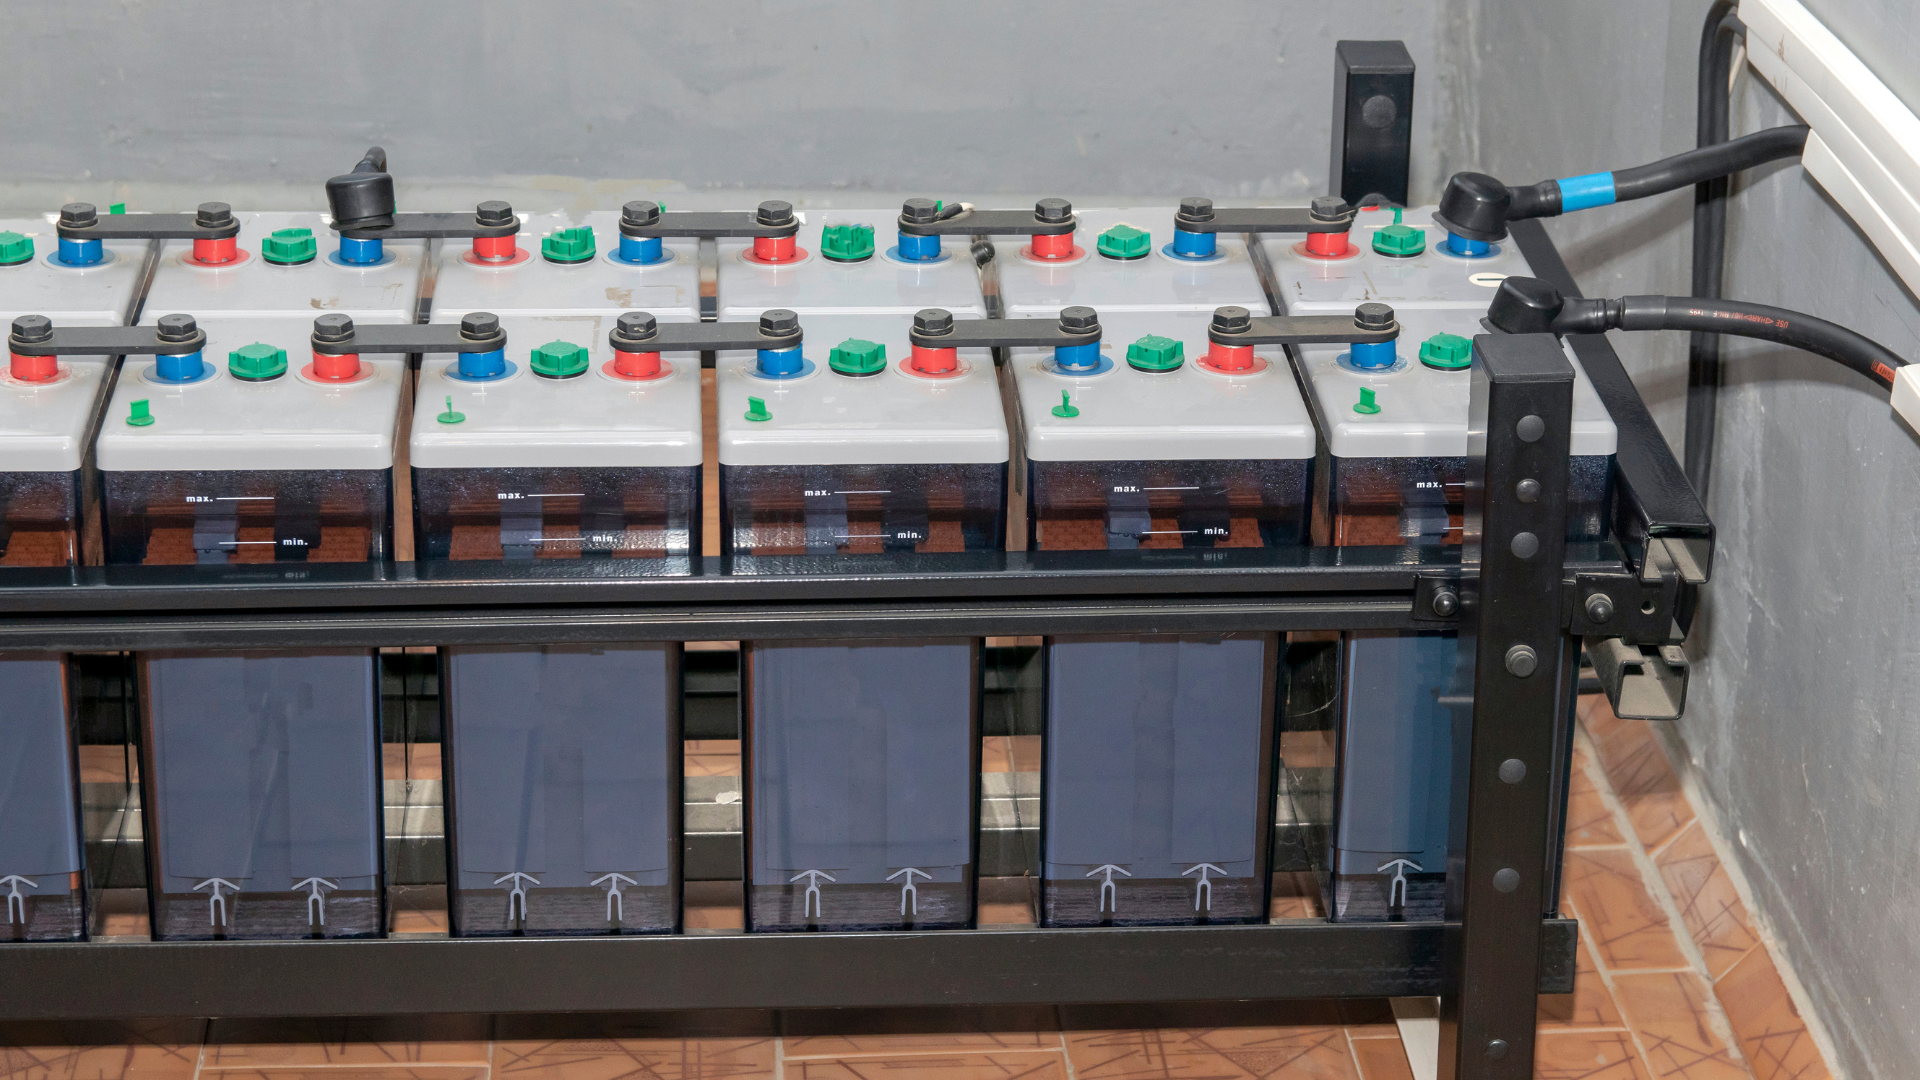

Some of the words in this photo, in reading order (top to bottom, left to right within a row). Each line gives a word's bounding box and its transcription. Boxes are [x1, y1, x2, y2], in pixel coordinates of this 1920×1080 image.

[1775, 319, 1789, 329] USE
[804, 489, 831, 497] max.
[1114, 485, 1140, 493] max.
[186, 495, 214, 503] max.
[497, 492, 525, 500] max.
[897, 530, 922, 539] min.
[1204, 527, 1228, 535] min.
[283, 537, 309, 546] min.
[592, 533, 618, 543] min.
